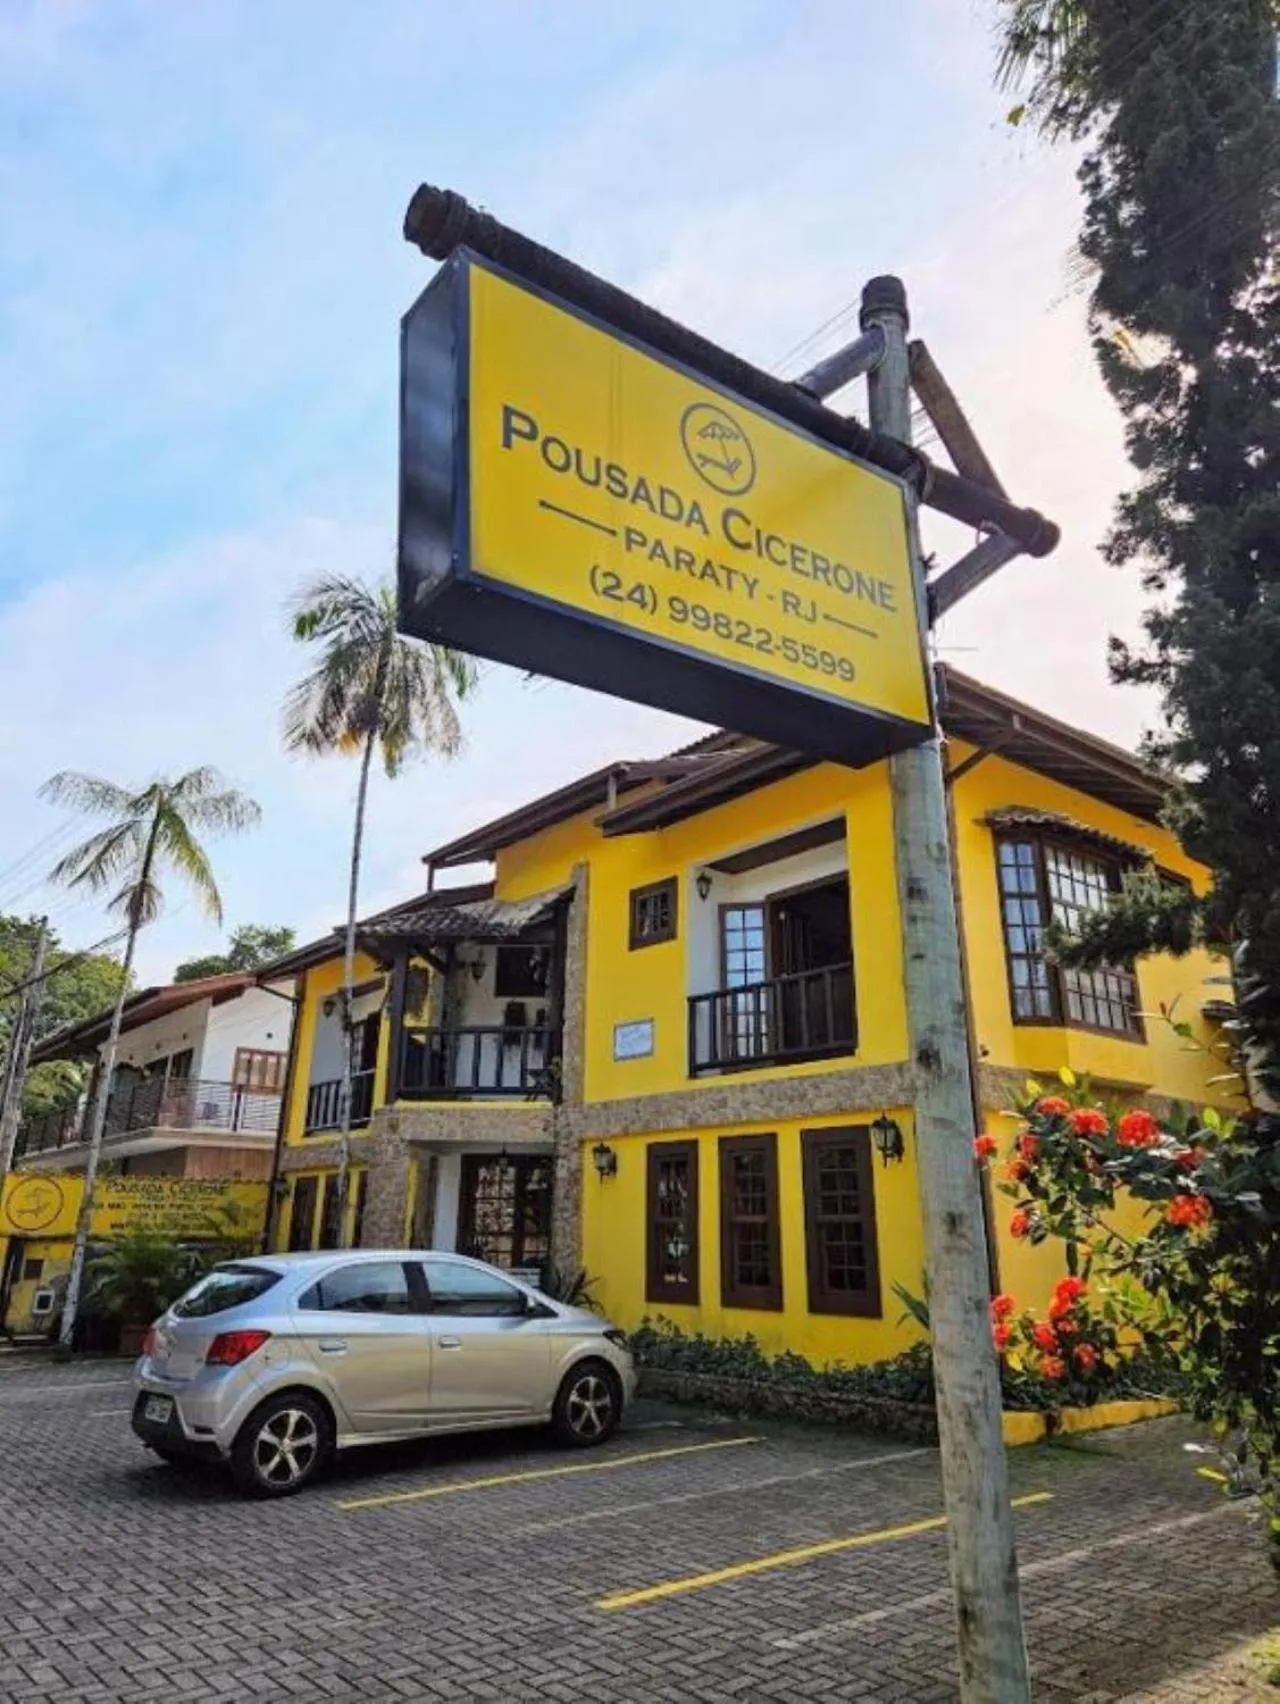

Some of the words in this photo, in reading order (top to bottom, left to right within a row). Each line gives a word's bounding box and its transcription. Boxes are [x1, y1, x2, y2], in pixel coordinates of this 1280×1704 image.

[501, 403, 709, 536] POUSADA
[720, 507, 898, 613] CICERONE
[589, 564, 658, 616] (24)
[667, 594, 856, 683] 99822-5599
[624, 526, 760, 600] PARATY
[781, 589, 818, 624] RJ
